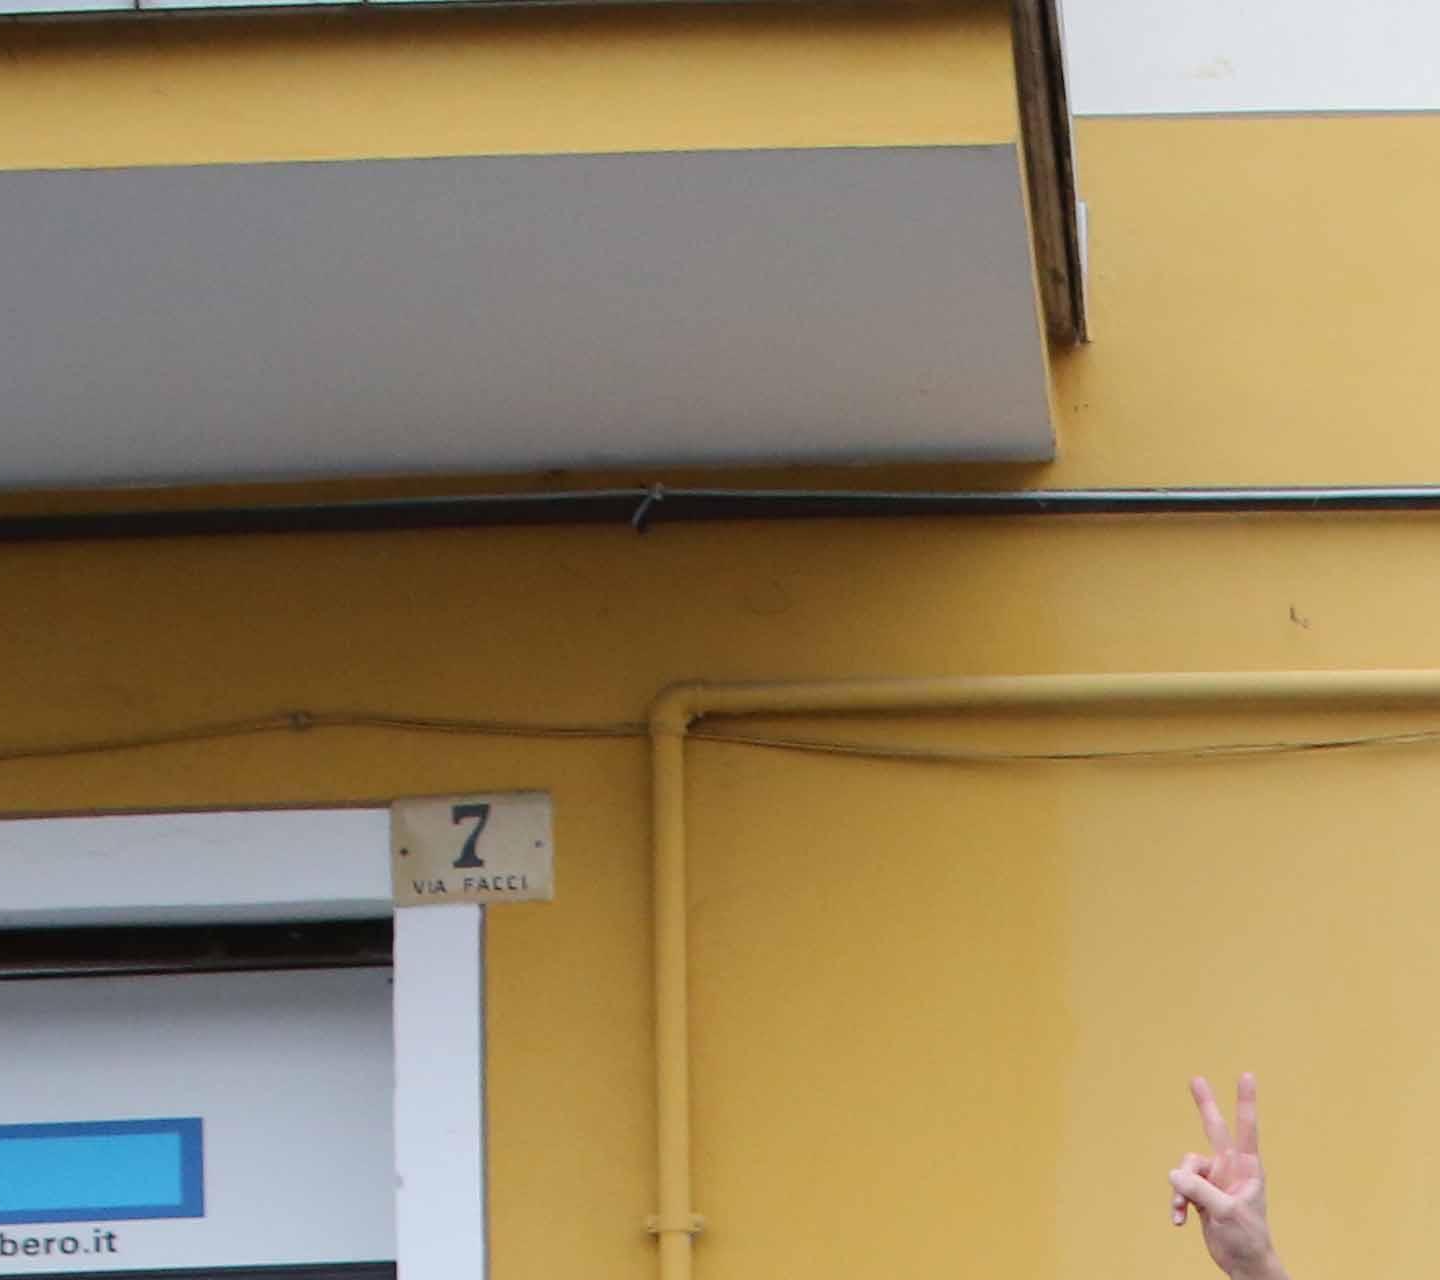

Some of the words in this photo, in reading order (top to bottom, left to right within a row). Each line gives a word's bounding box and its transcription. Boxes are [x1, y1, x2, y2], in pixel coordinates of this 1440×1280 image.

[452, 803, 492, 869] 7
[412, 879, 448, 895] VIA
[463, 875, 529, 893] FACCI
